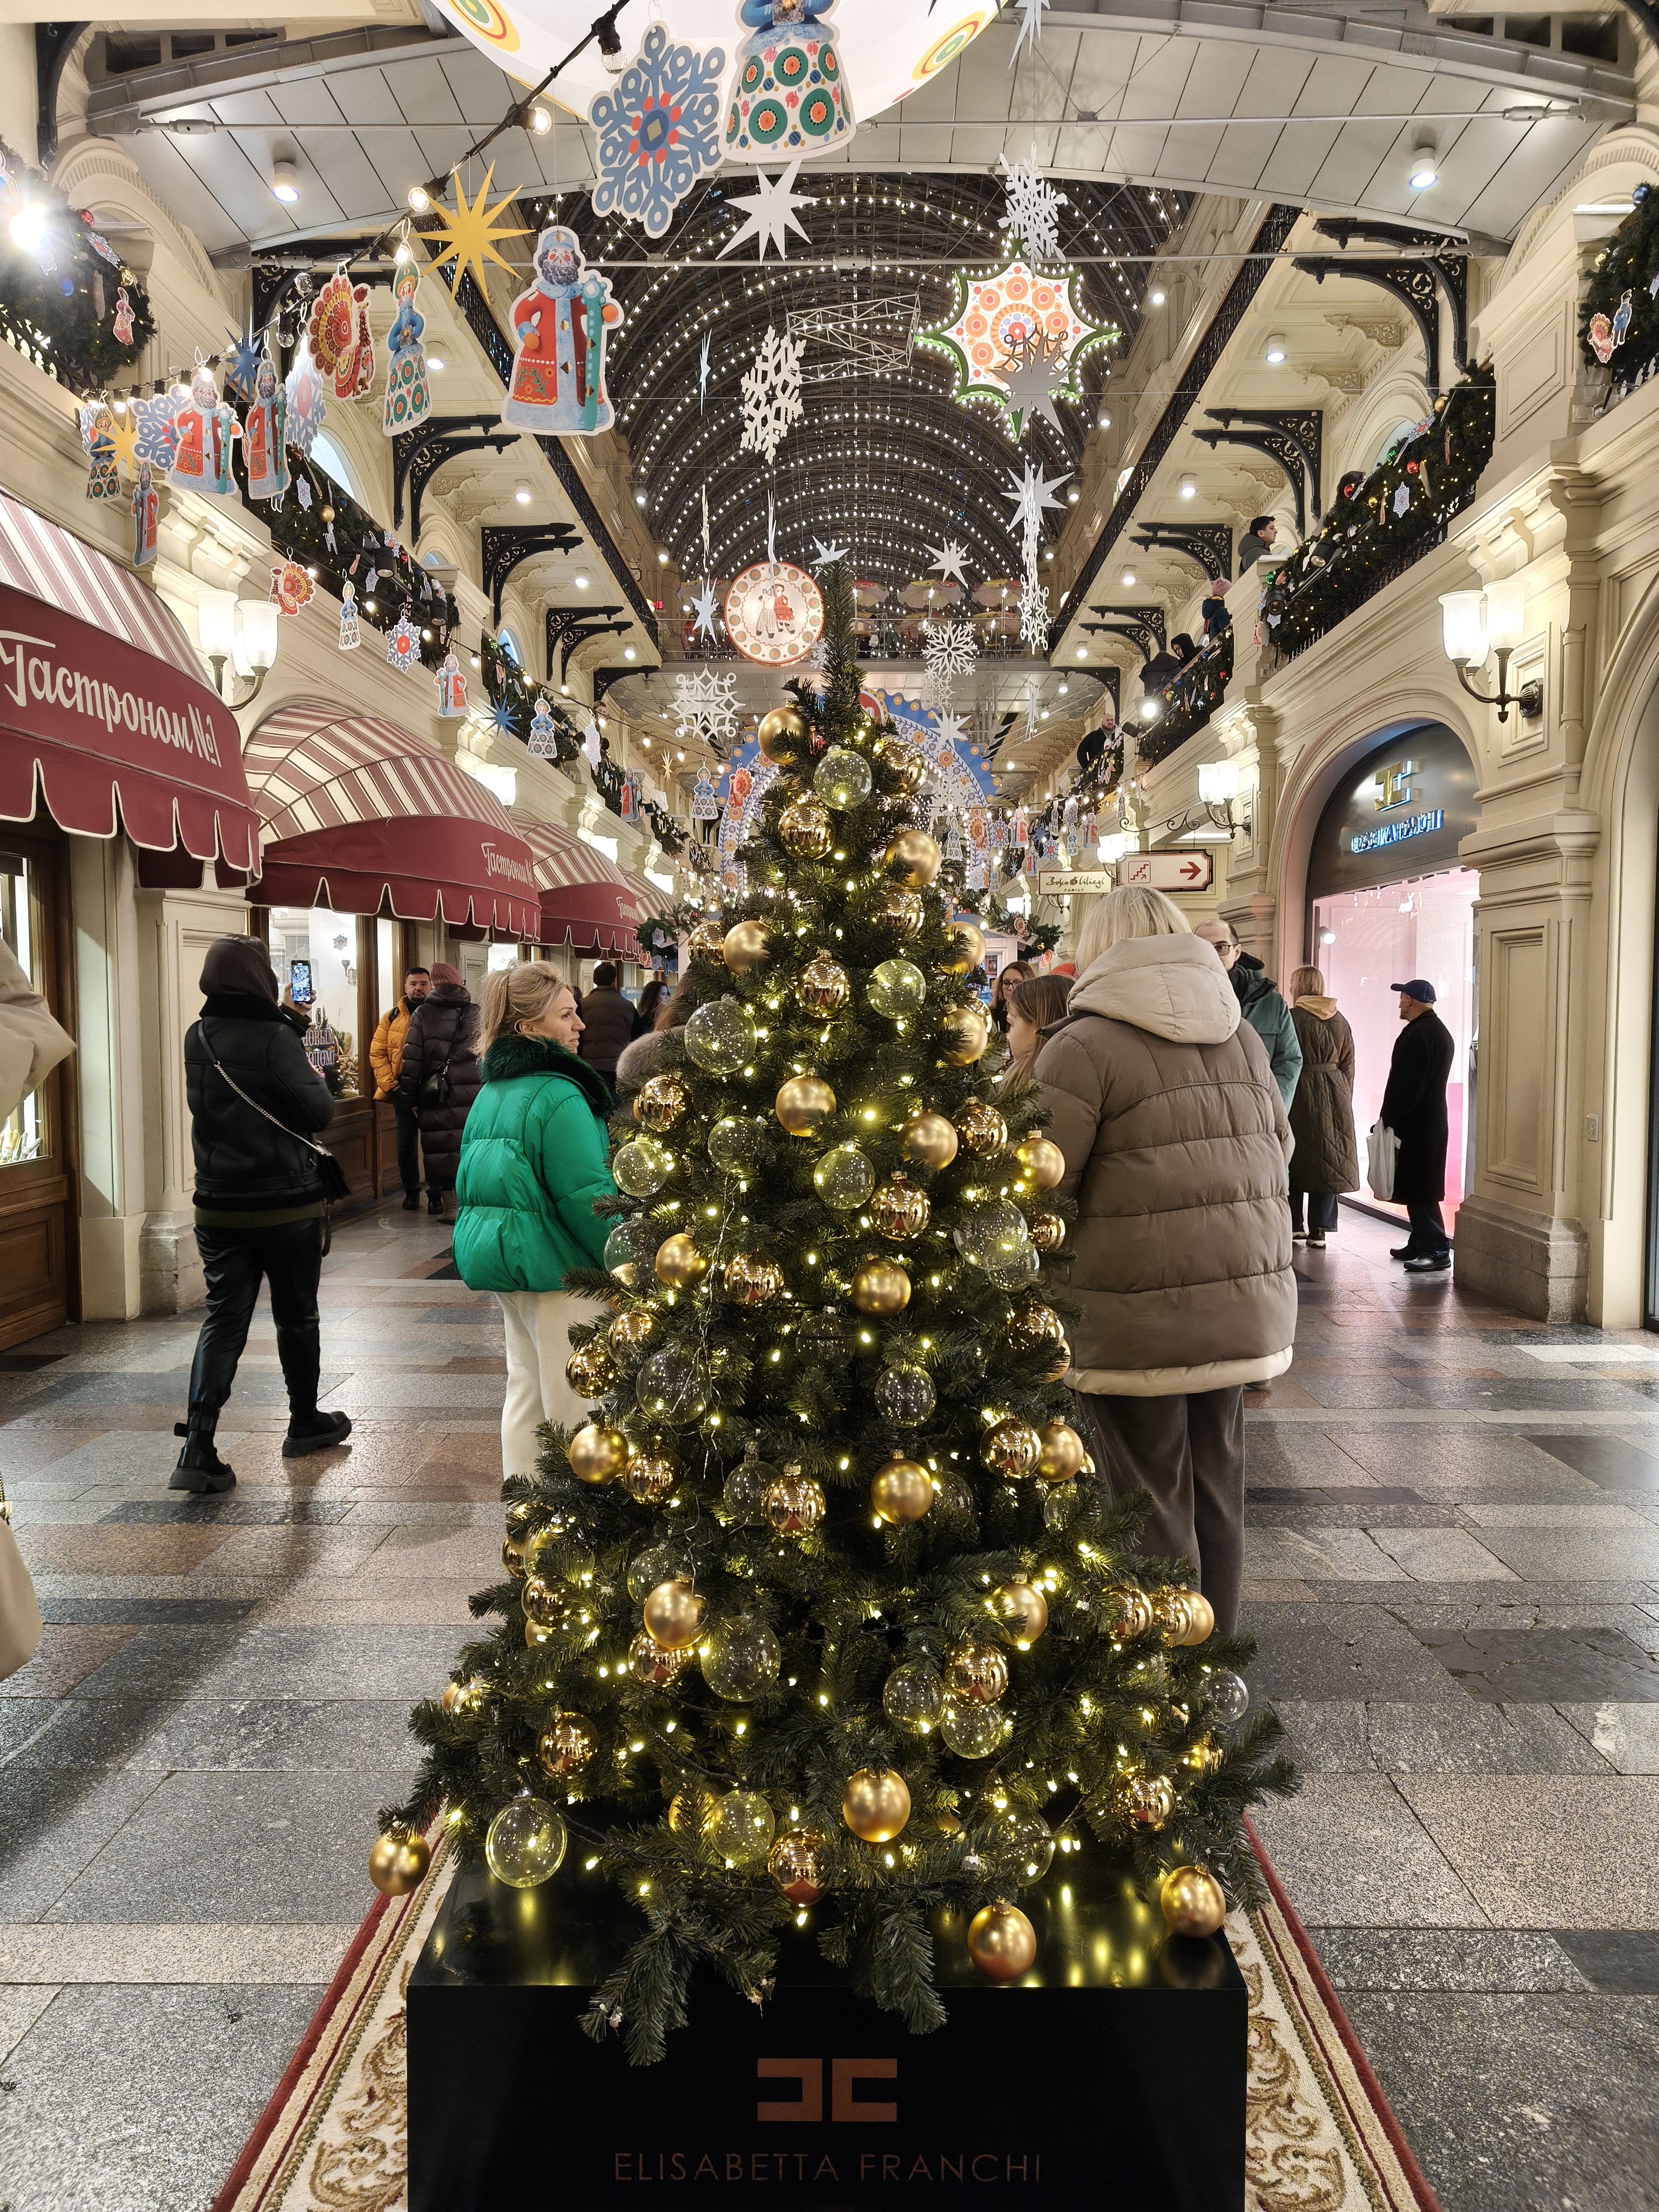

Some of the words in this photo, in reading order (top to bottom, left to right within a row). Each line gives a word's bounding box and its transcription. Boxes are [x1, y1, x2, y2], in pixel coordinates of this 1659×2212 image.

[0, 630, 193, 754] Гастроном
[481, 842, 528, 885] Гастроном
[614, 2153, 839, 2181] ELISABETTA
[860, 2153, 1041, 2182] FRANCHI
